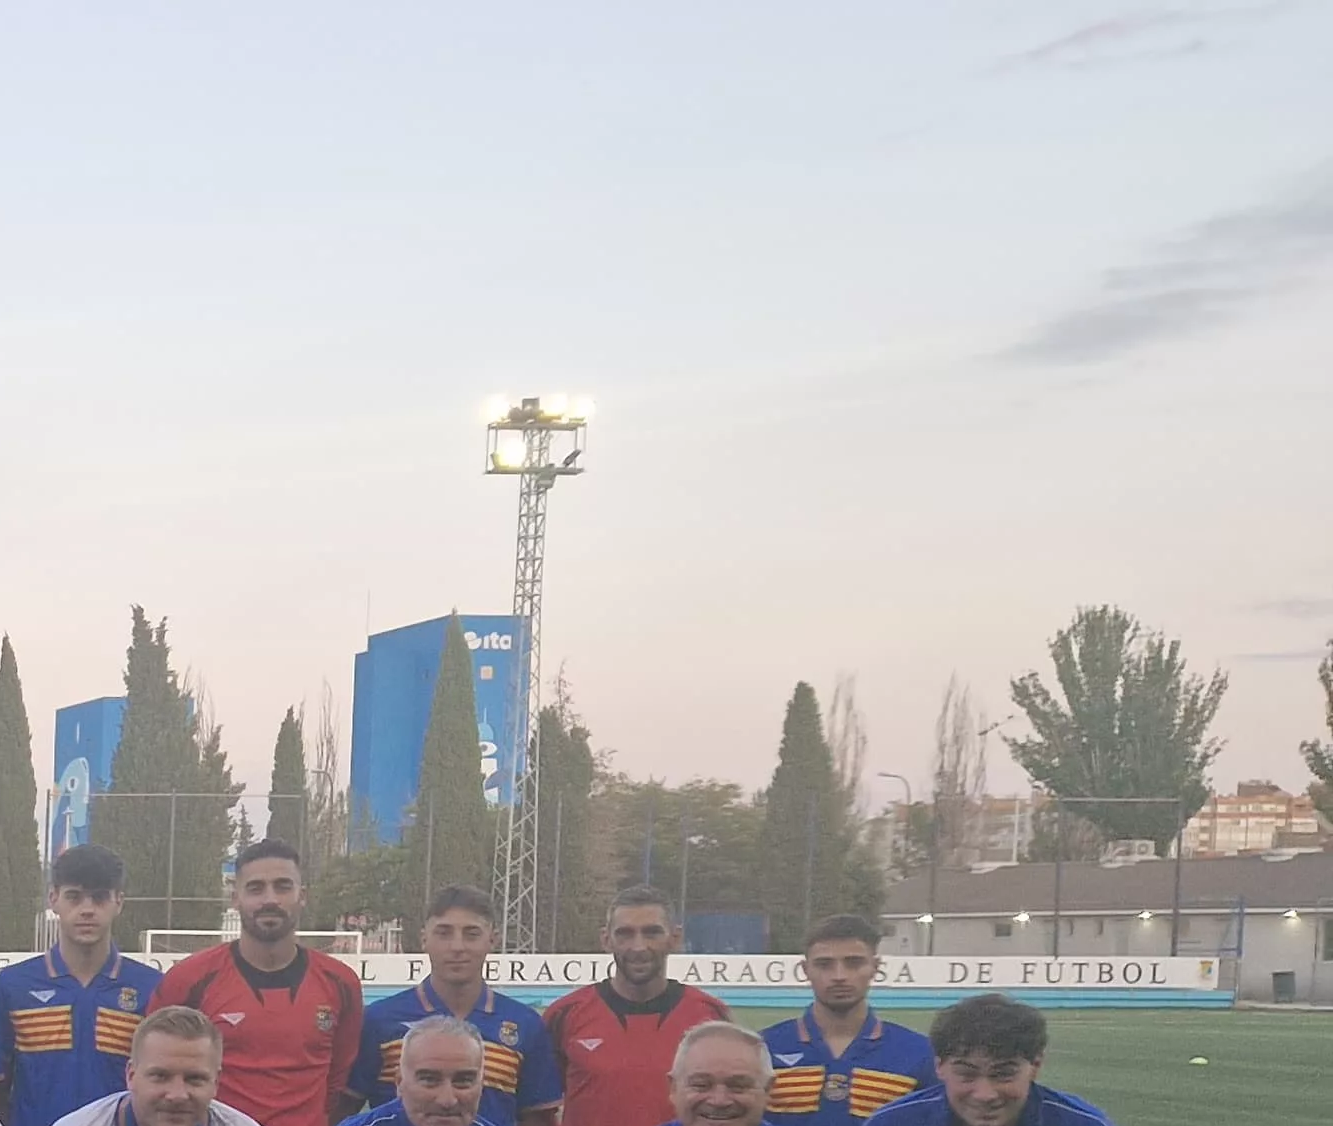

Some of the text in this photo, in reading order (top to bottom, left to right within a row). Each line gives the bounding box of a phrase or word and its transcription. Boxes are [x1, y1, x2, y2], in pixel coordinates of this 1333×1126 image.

[407, 959, 616, 982] FERACI
[683, 961, 915, 983] ARAGOSA
[948, 962, 994, 984] DE
